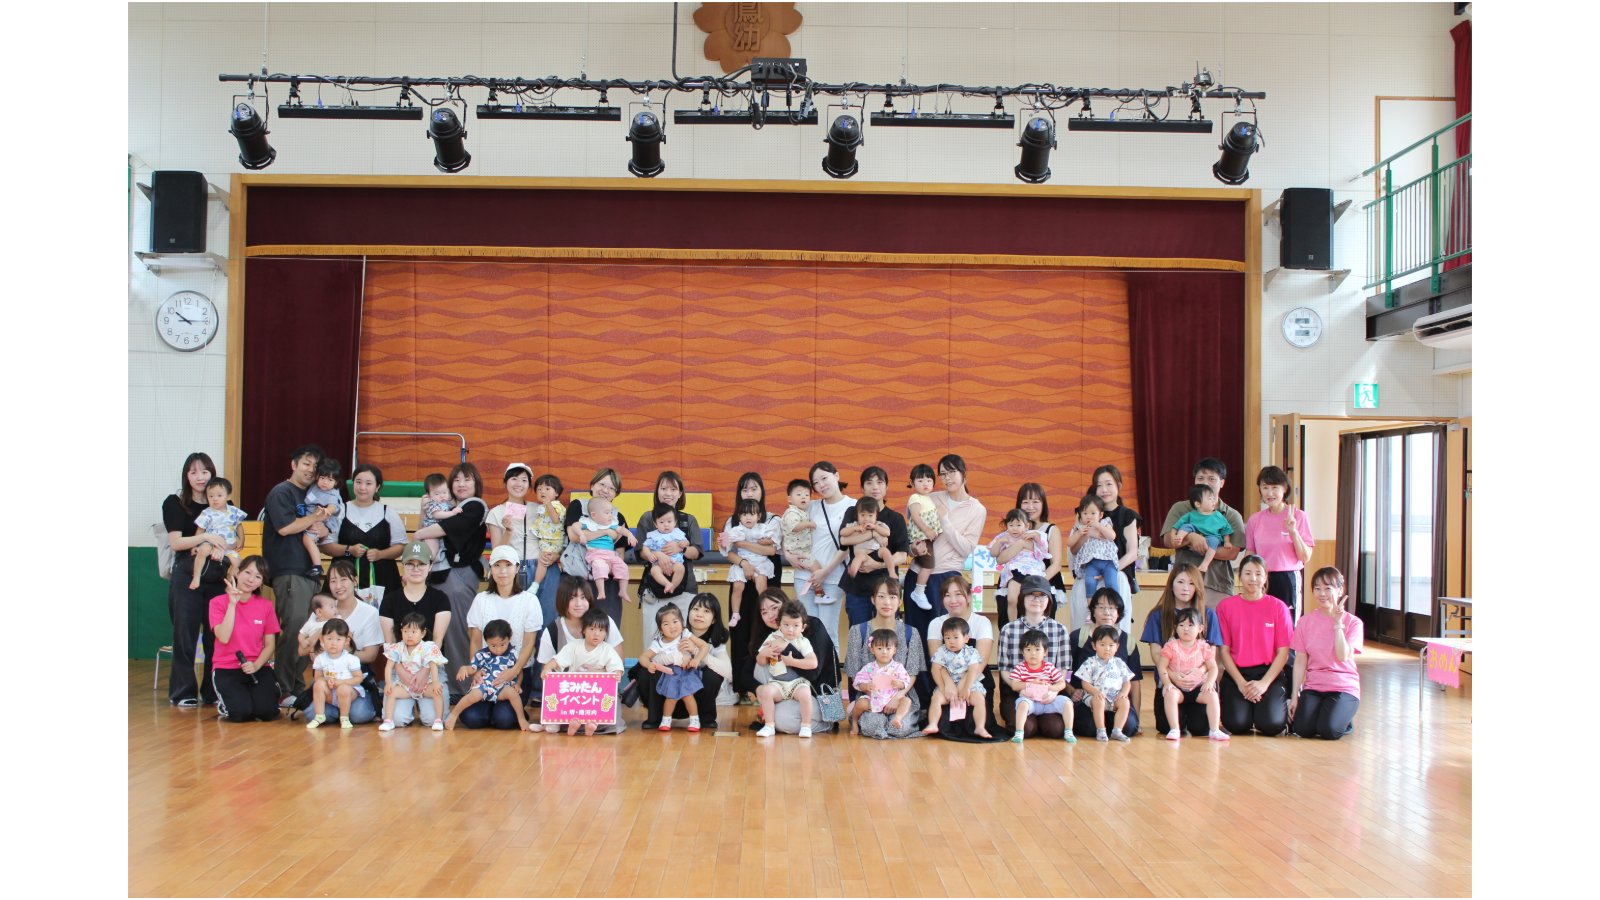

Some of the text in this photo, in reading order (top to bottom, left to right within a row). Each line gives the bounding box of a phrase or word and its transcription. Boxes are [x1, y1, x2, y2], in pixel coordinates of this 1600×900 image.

[175, 299, 182, 308] 11
[183, 297, 192, 306] 12
[167, 307, 175, 315] 10
[202, 307, 208, 316] 2
[163, 316, 170, 325] 9
[167, 327, 173, 336] 8
[201, 327, 207, 336] 4
[174, 334, 181, 343] 7
[183, 336, 190, 345] 6
[193, 334, 200, 343] 5
[559, 680, 602, 694] まみたん
[560, 695, 600, 706] イベント
